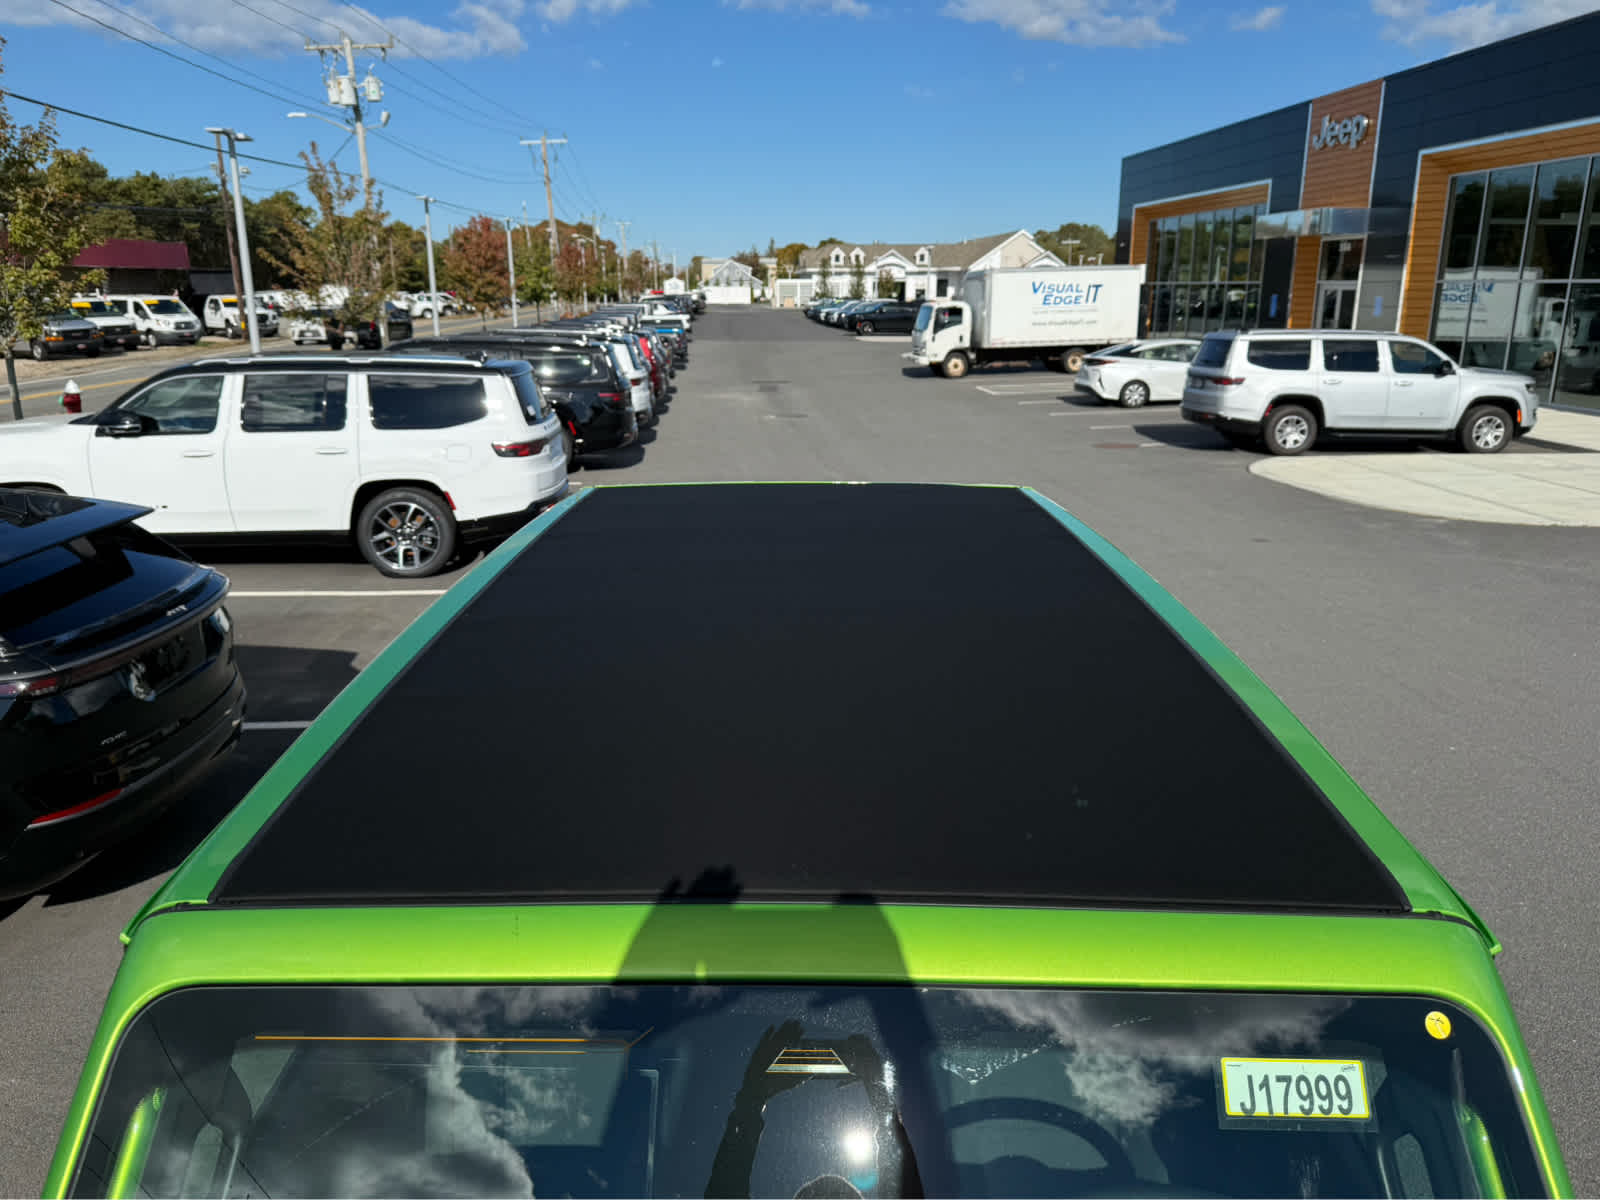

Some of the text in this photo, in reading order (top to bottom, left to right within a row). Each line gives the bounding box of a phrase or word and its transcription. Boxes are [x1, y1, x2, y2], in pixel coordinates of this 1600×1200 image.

[1313, 114, 1369, 149] Jeep
[1032, 281, 1083, 294] VISUAL
[1042, 283, 1103, 305] EDGE IT
[1240, 1074, 1353, 1116] J17999
